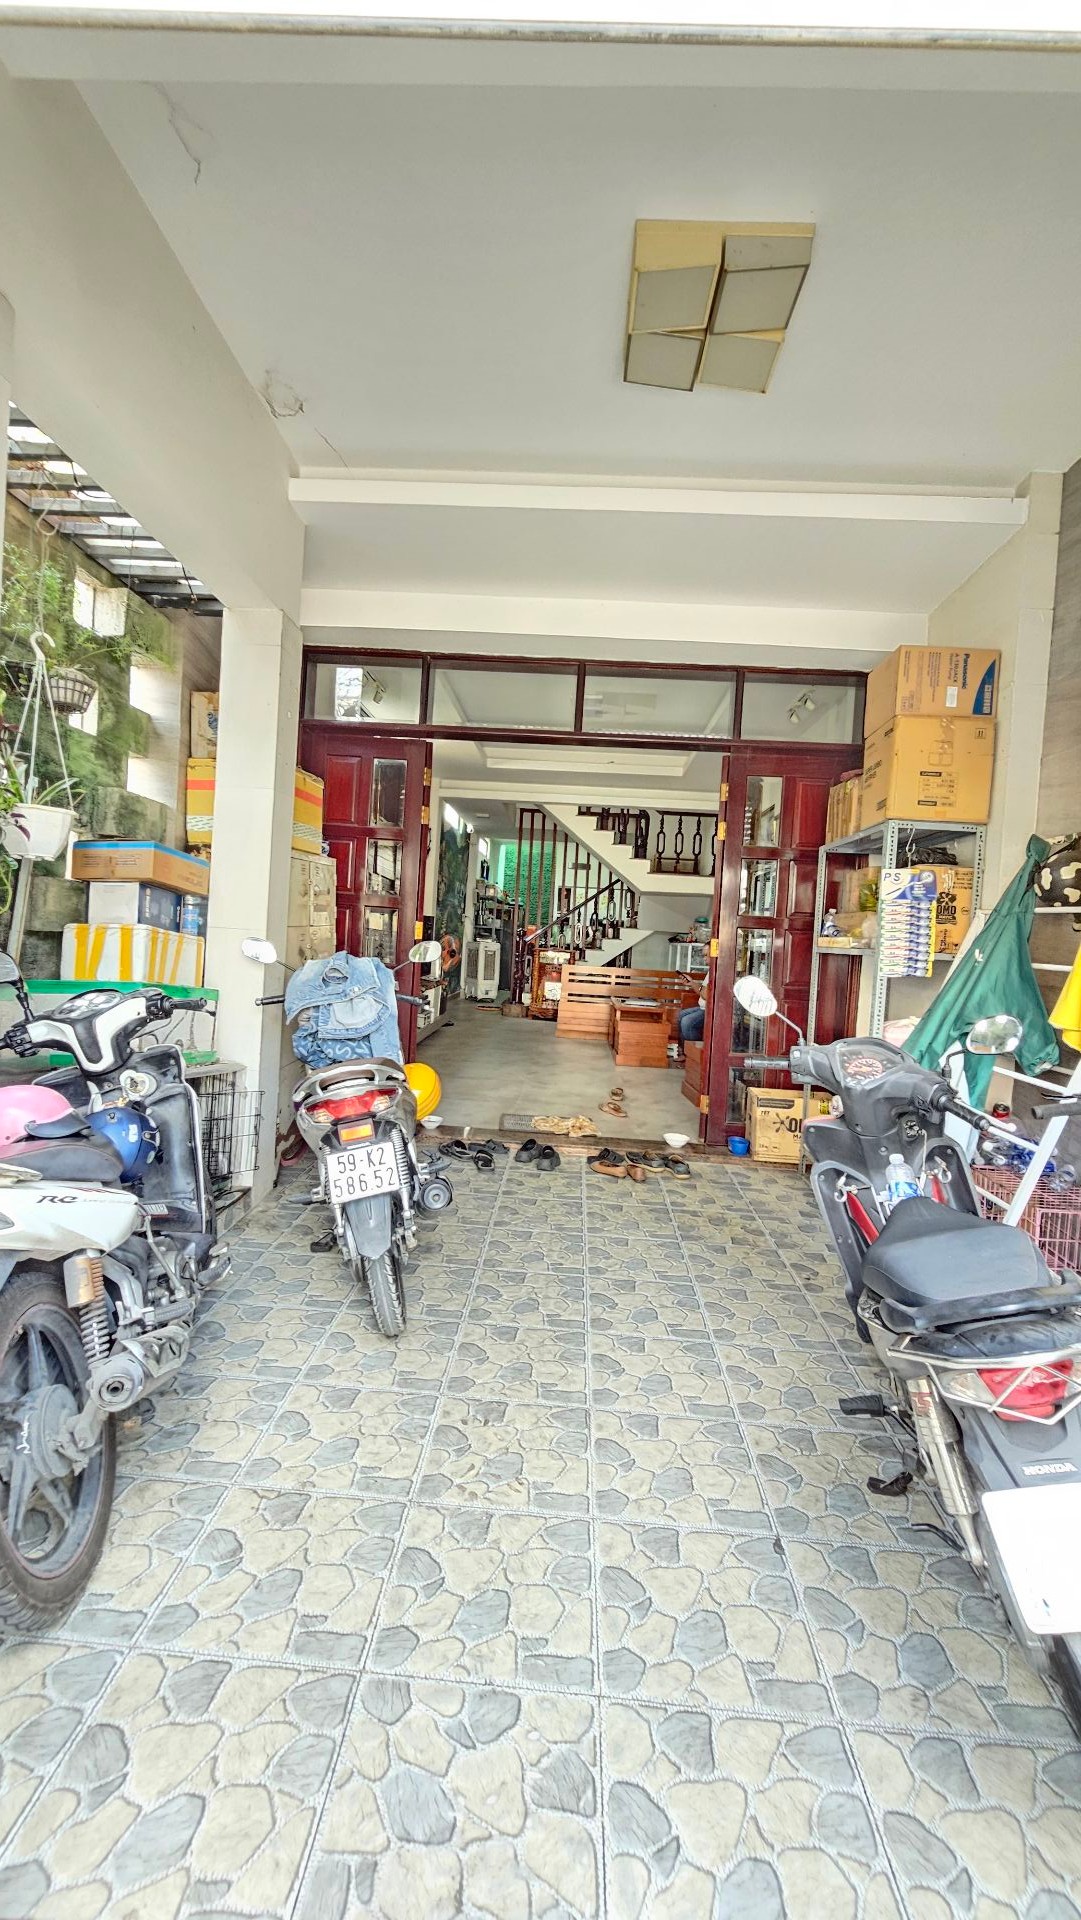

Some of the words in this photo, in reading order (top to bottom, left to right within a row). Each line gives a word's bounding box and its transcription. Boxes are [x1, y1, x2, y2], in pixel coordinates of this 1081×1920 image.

[961, 653, 970, 689] Panasonic
[936, 905, 956, 915] OMO
[337, 1147, 386, 1174] 59-K2
[334, 1167, 396, 1197] 586.52
[1022, 1462, 1078, 1475] HONDA
